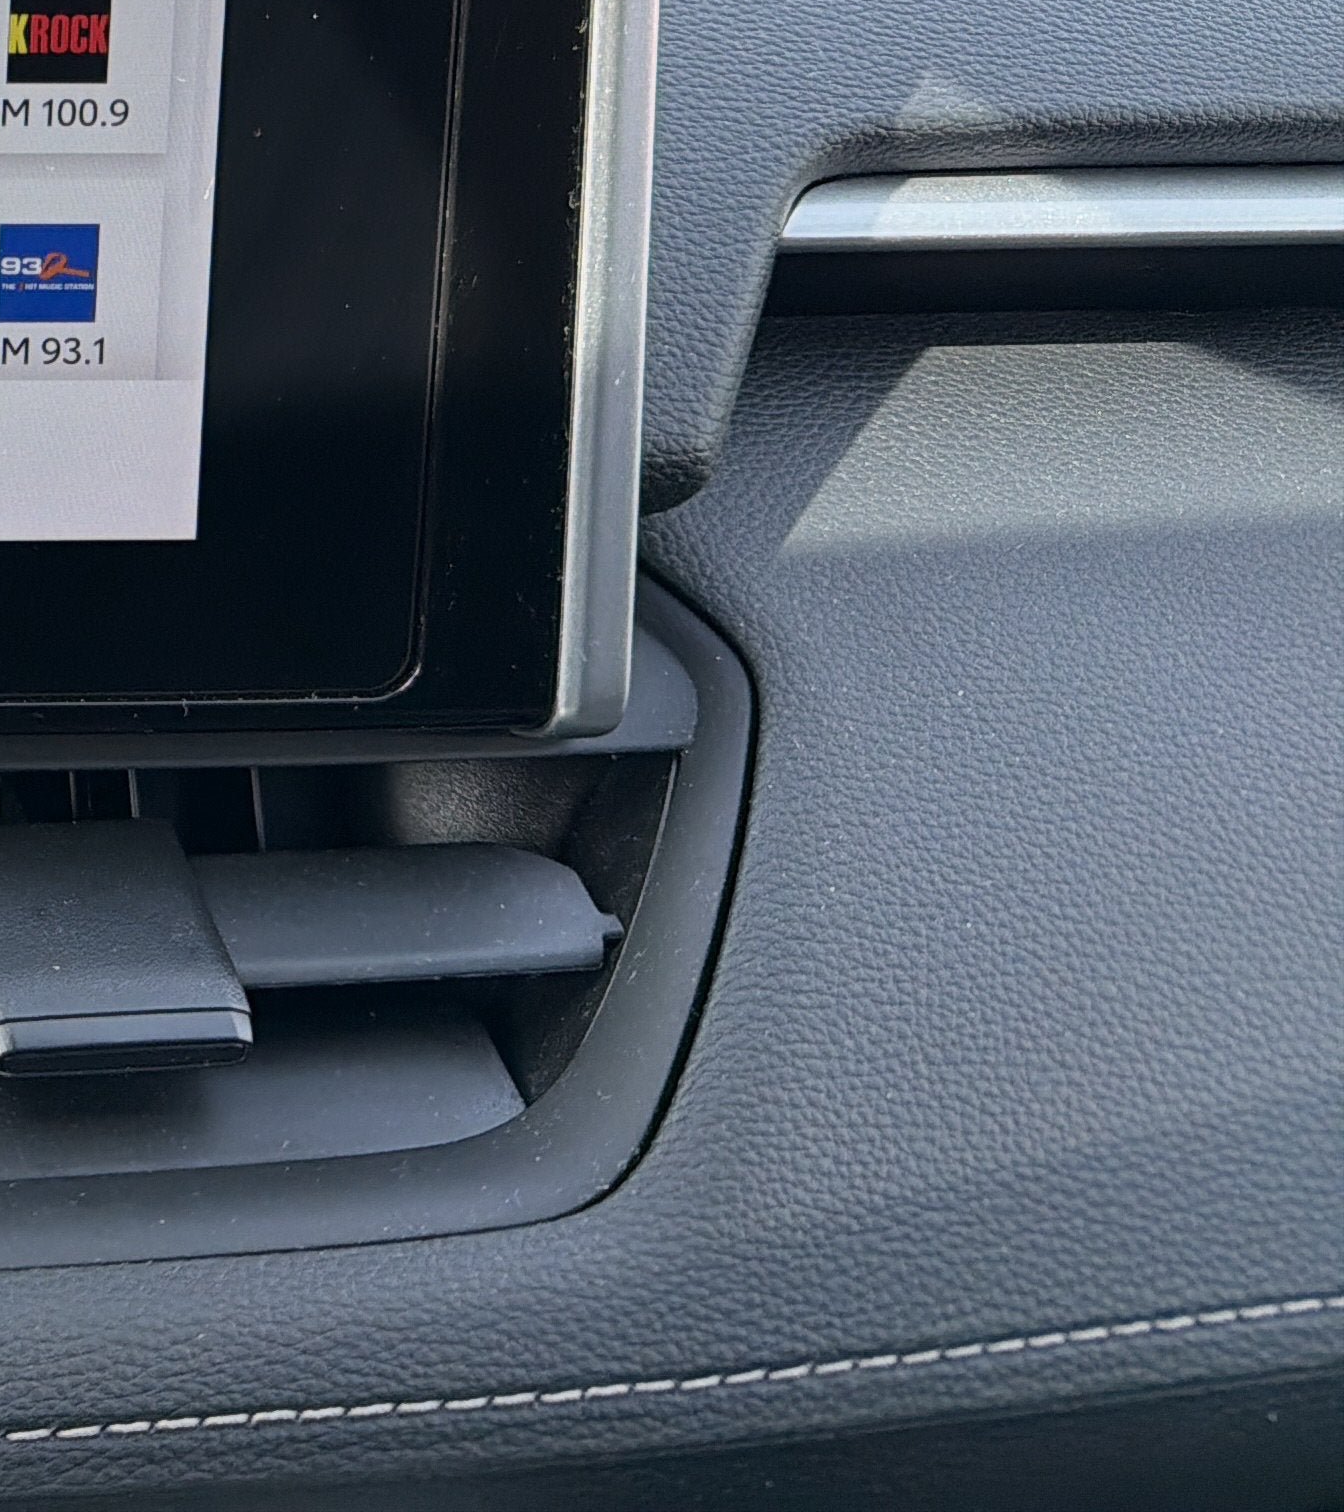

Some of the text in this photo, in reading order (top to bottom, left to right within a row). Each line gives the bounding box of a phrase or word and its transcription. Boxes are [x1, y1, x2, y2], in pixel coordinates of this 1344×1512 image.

[8, 13, 109, 55] KROCK
[42, 98, 130, 127] 100.9
[41, 337, 106, 366] 93.1
